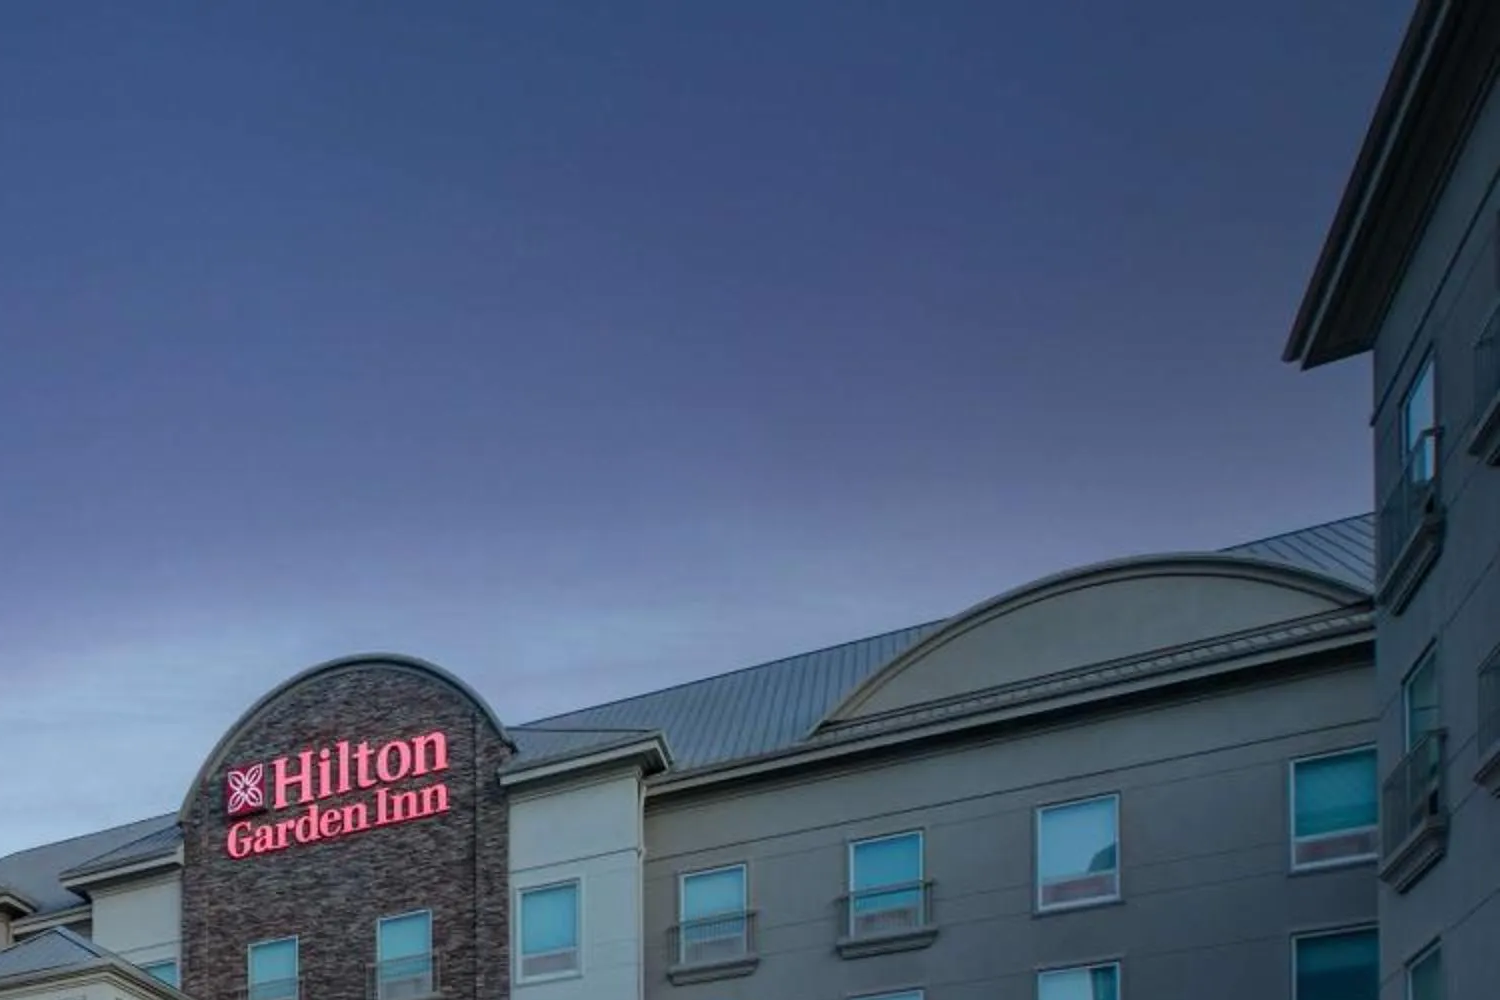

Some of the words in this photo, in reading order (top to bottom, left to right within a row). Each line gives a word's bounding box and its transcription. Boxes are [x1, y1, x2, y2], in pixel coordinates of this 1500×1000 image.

[271, 730, 449, 810] Hilton
[227, 804, 370, 859] Garden
[375, 782, 451, 826] Inn
